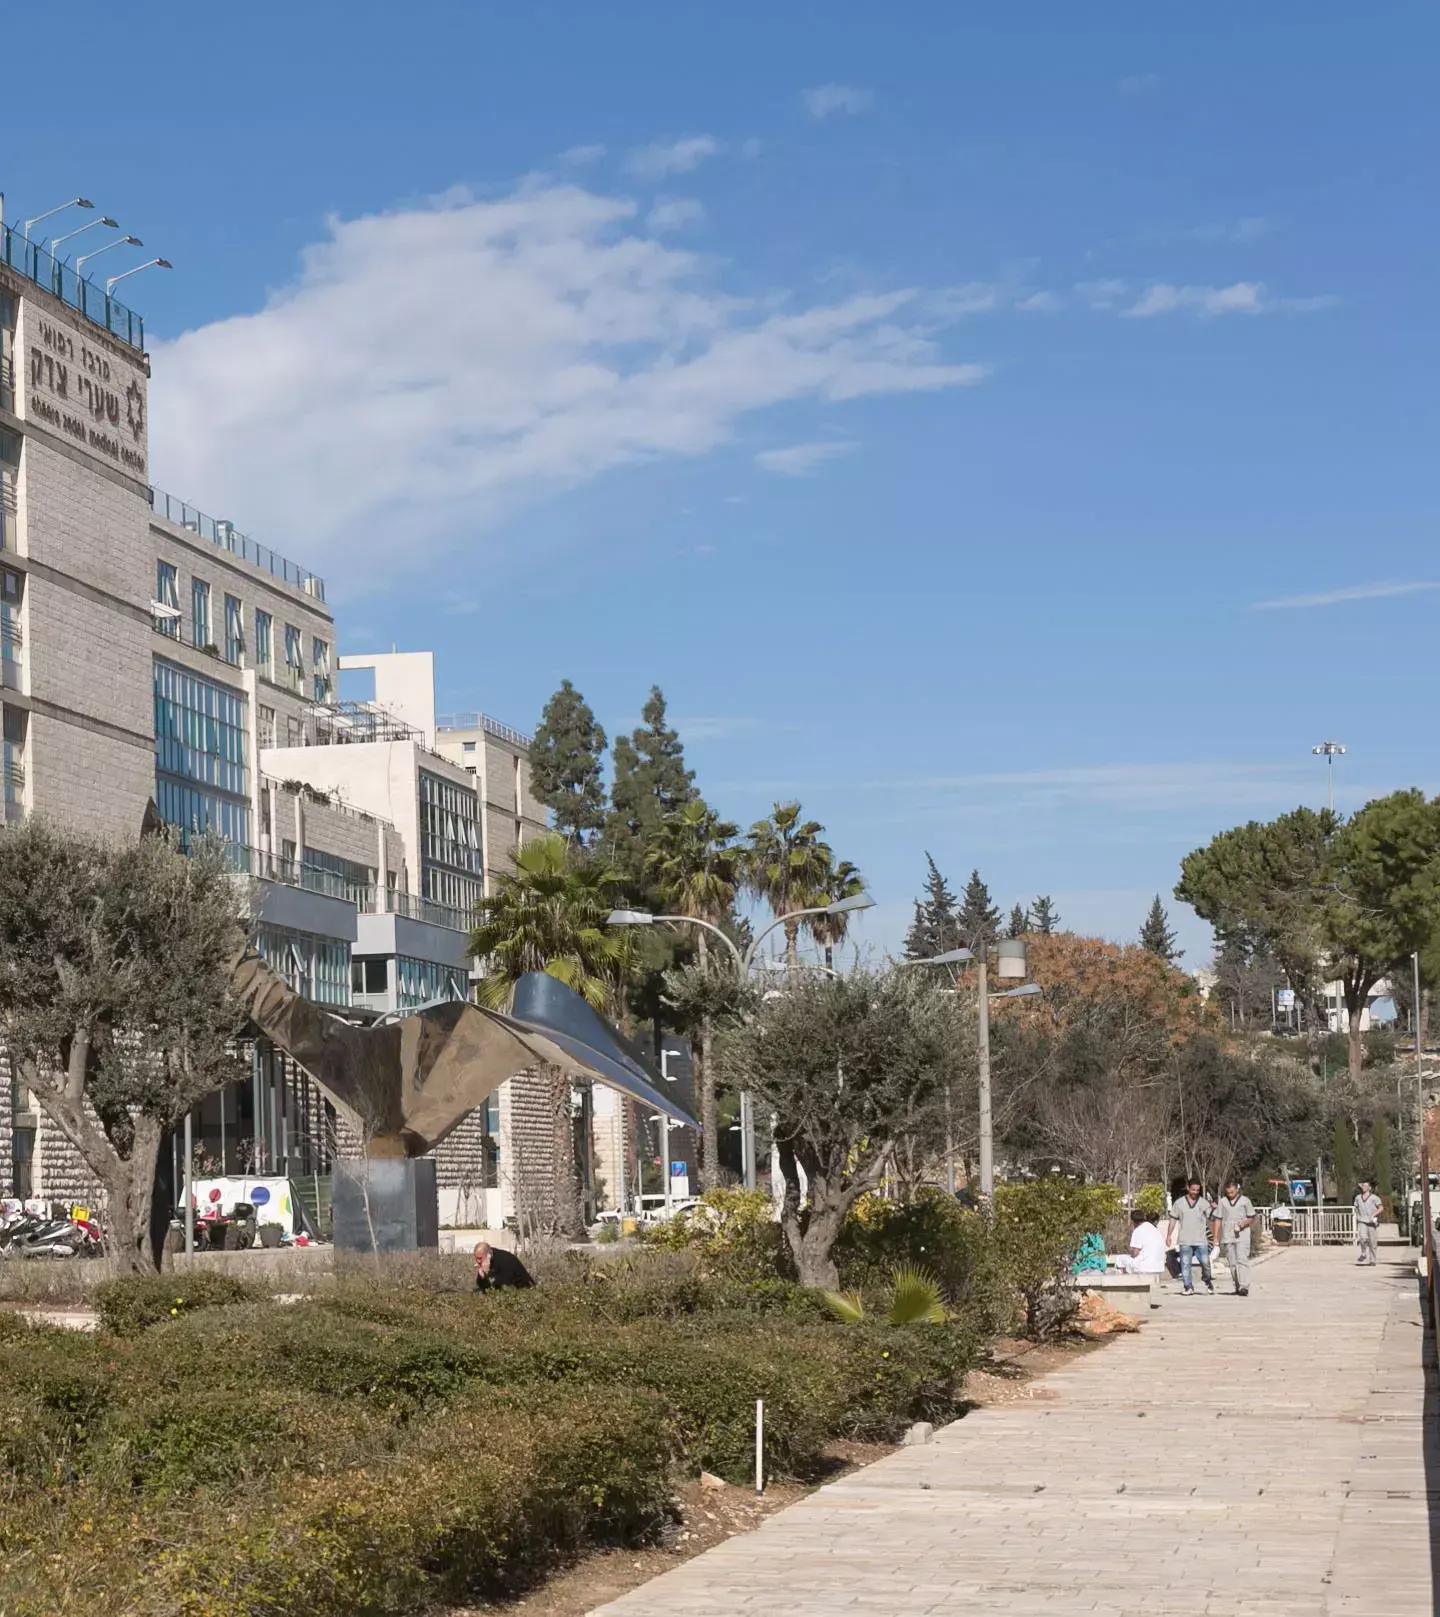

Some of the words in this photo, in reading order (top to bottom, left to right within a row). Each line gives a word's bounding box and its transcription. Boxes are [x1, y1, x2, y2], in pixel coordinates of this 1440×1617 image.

[38, 319, 73, 361] רפואי
[31, 346, 68, 400] צדק
[81, 346, 111, 383] מרכז
[78, 374, 120, 427] שערי
